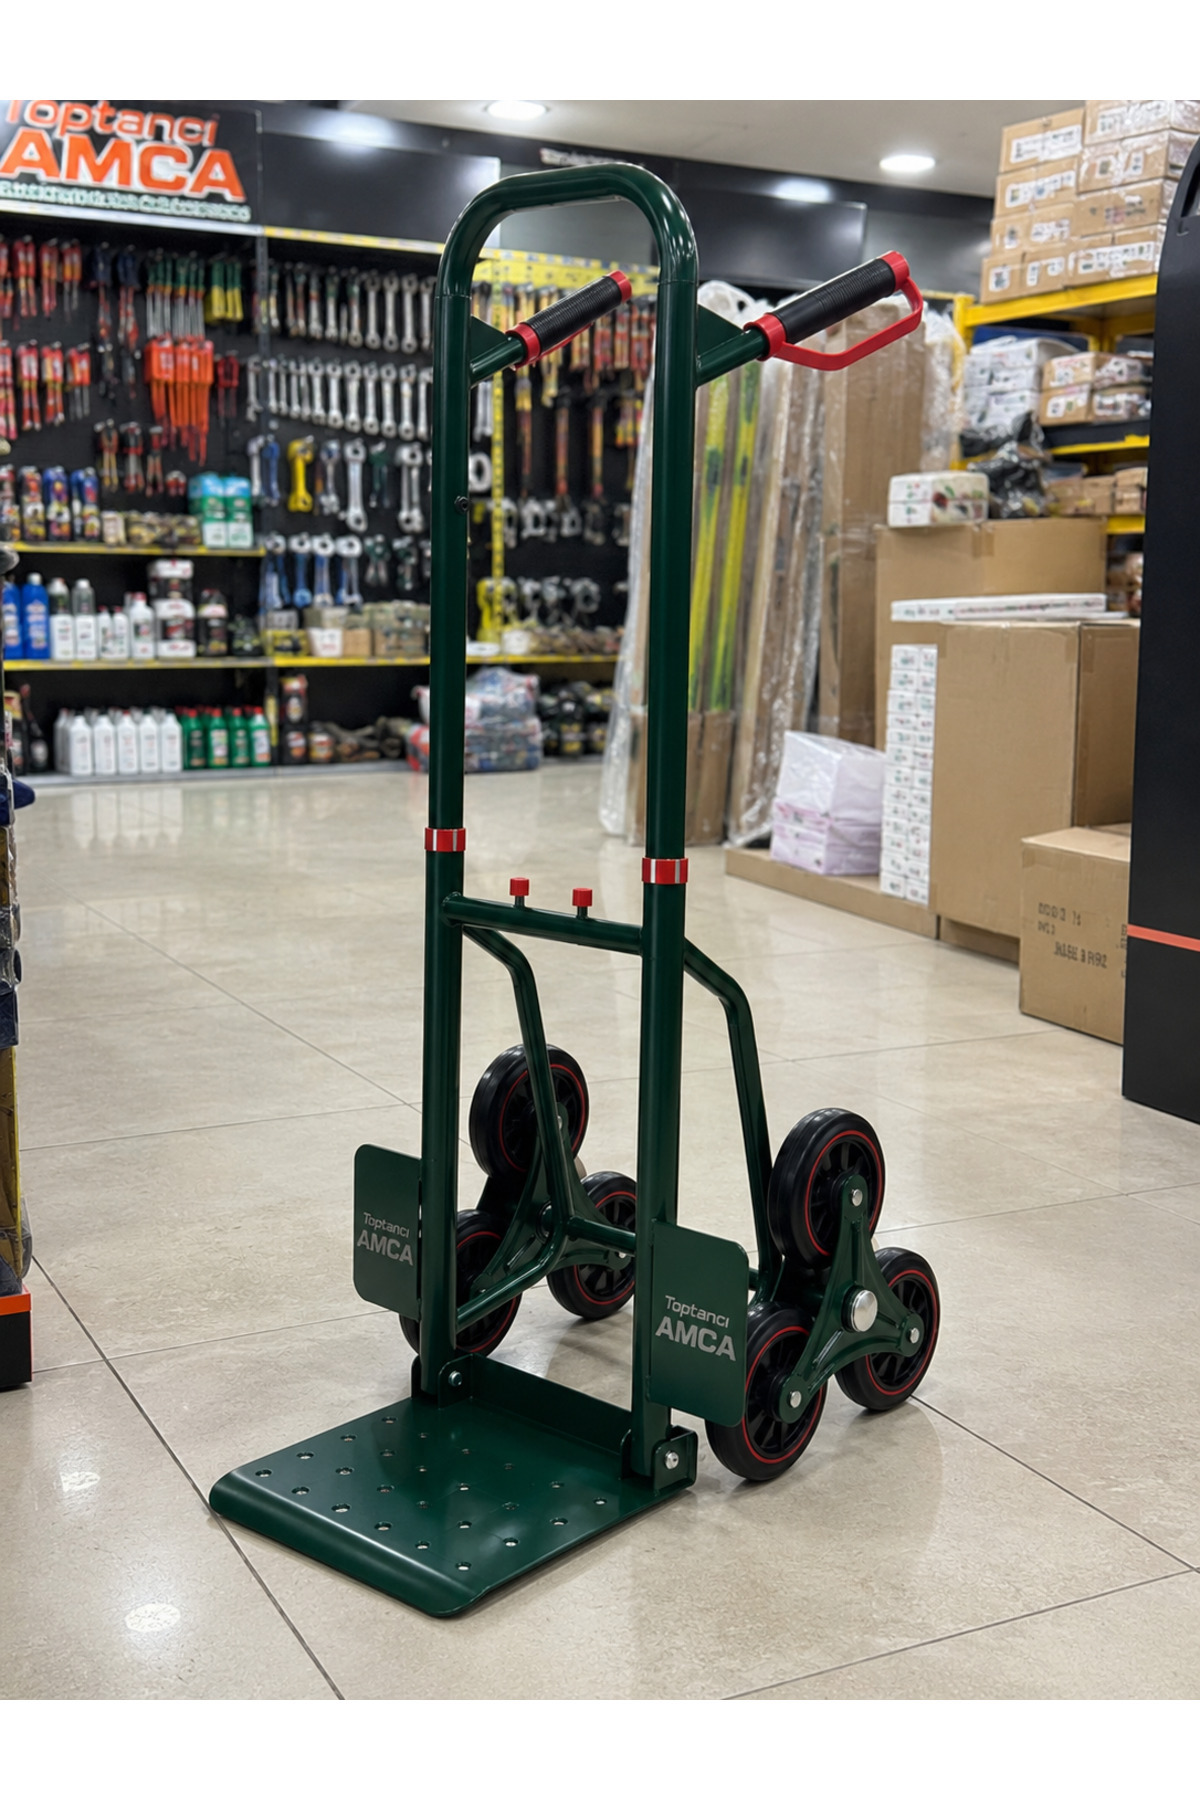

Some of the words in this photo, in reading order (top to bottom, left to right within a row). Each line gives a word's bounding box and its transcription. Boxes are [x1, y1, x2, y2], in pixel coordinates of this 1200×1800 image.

[0, 126, 246, 203] AMCA
[357, 1229, 414, 1266] AMCA
[655, 1316, 737, 1361] AMCA
